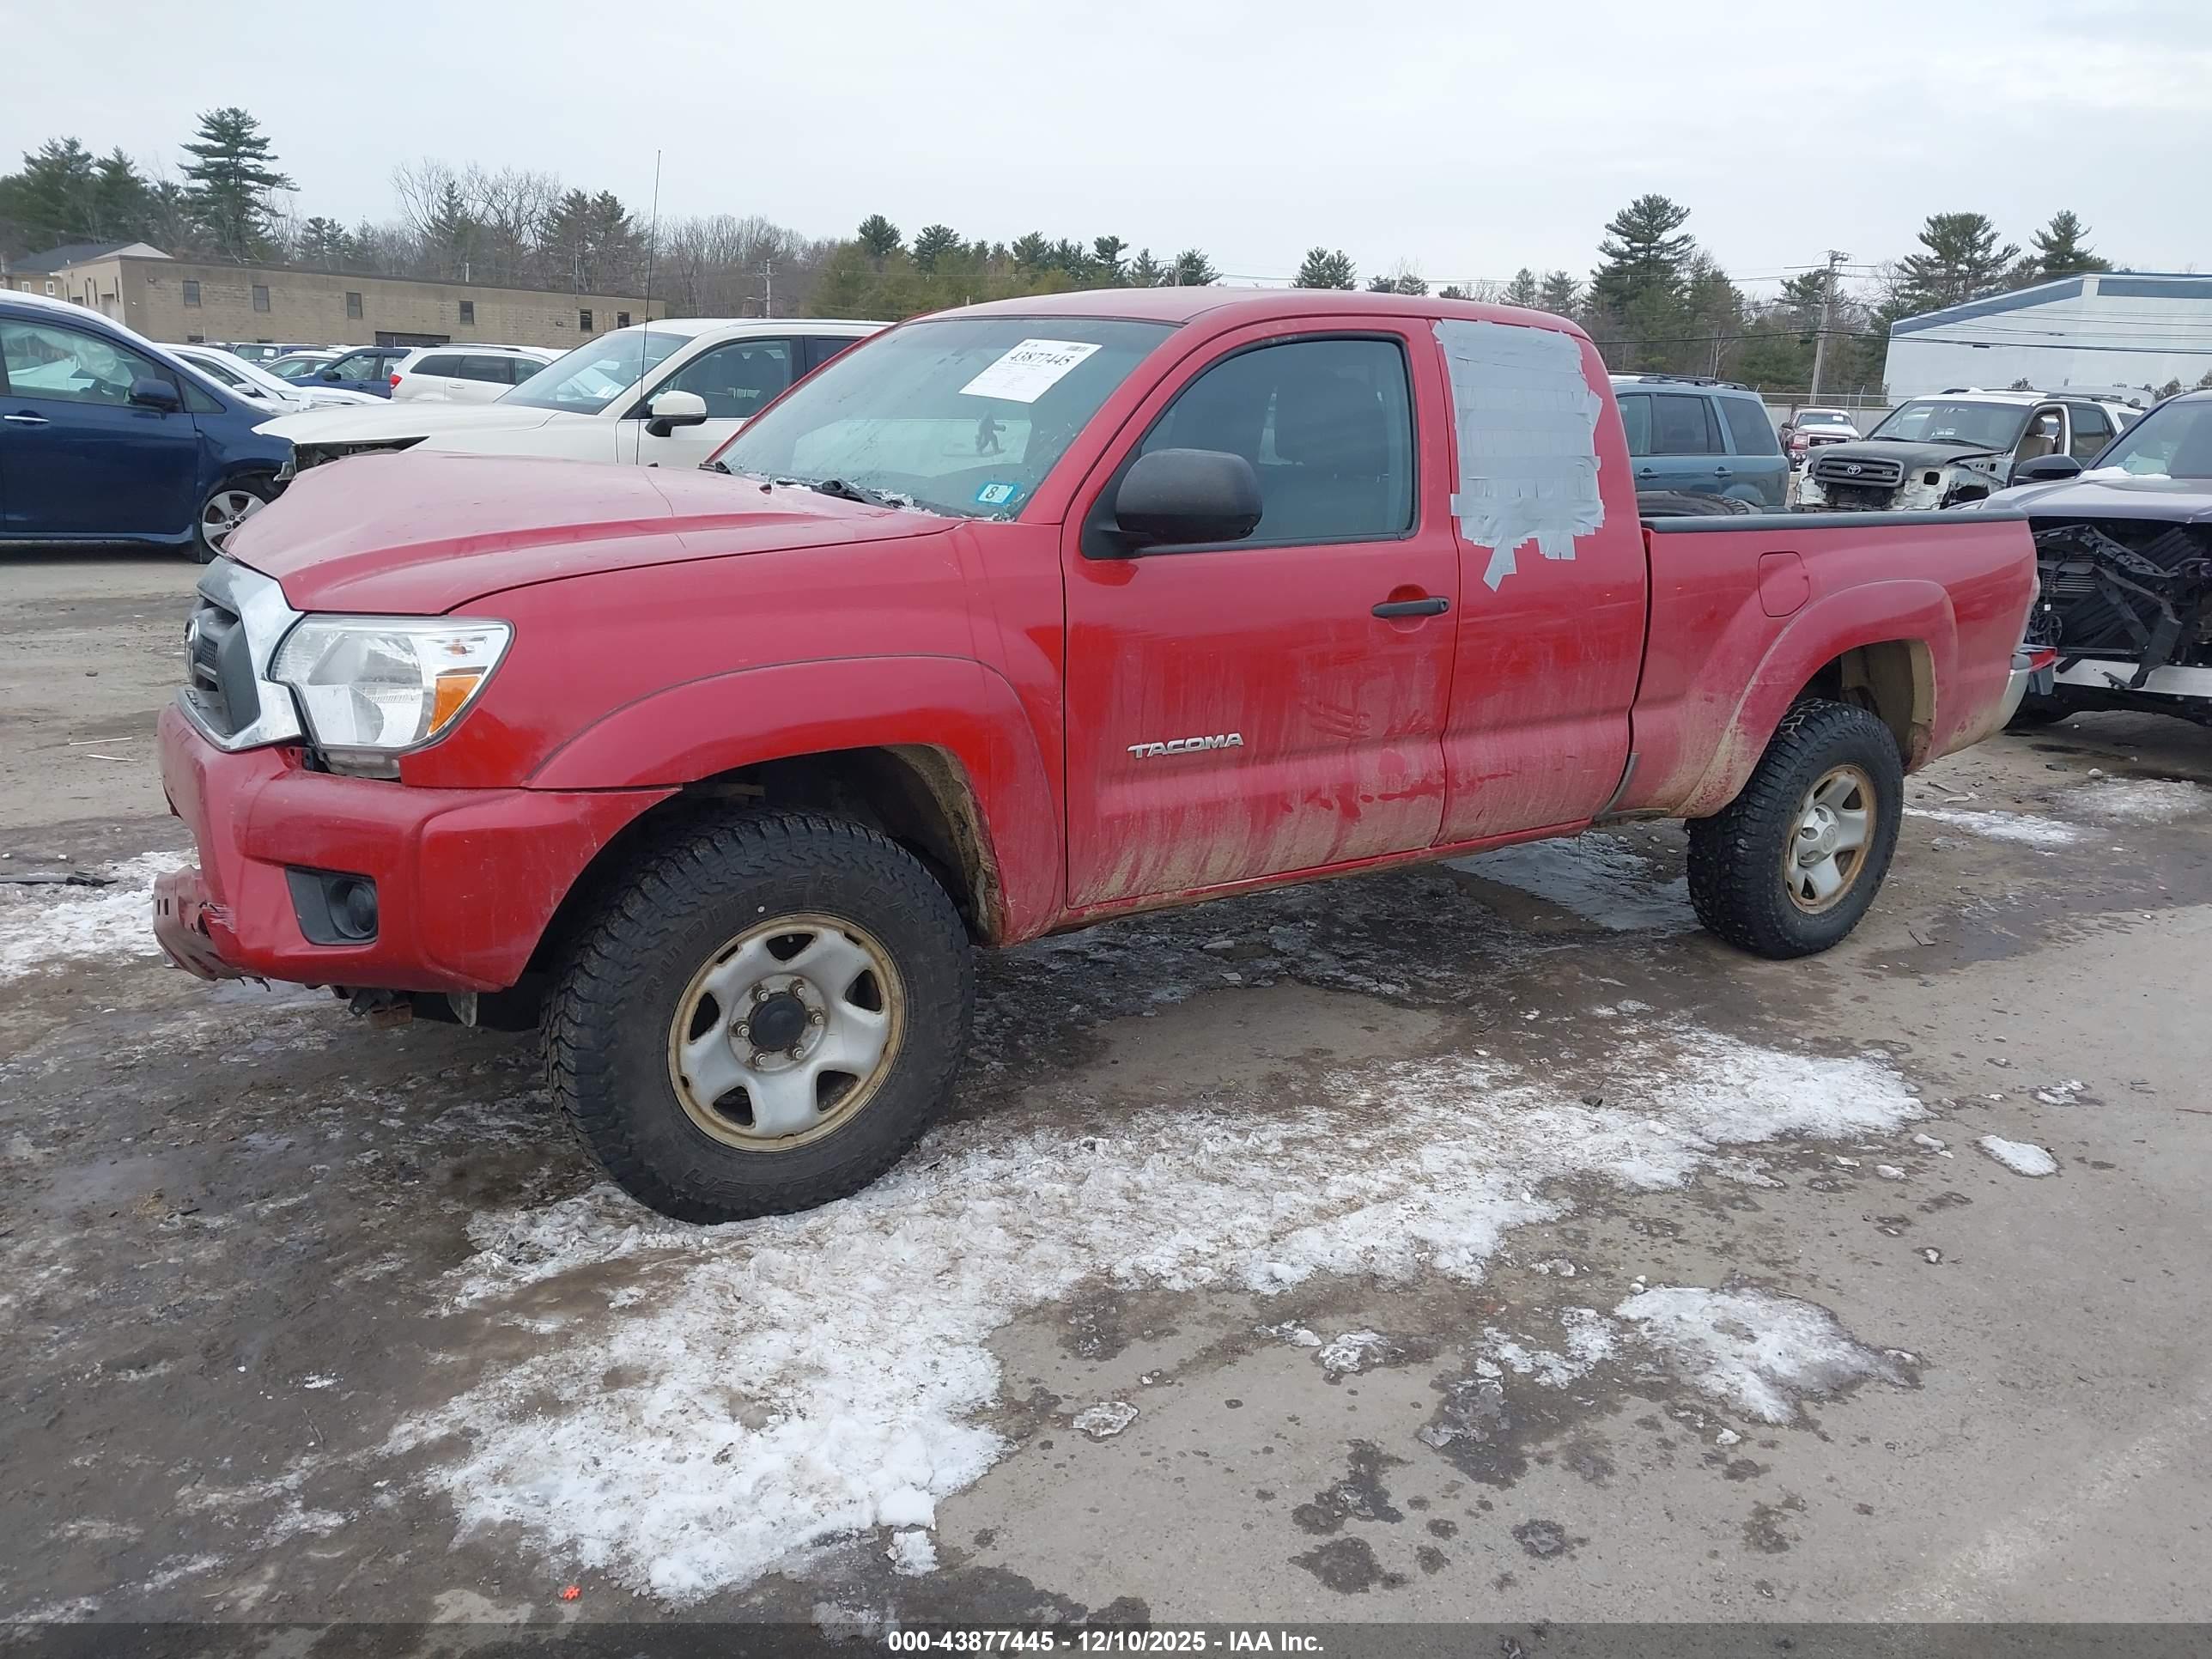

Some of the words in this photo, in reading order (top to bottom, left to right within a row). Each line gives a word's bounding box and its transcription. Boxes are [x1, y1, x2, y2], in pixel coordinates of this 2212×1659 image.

[1009, 350, 1075, 366] 43877445
[985, 486, 1000, 499] 8
[1127, 732, 1244, 759] TACOMA
